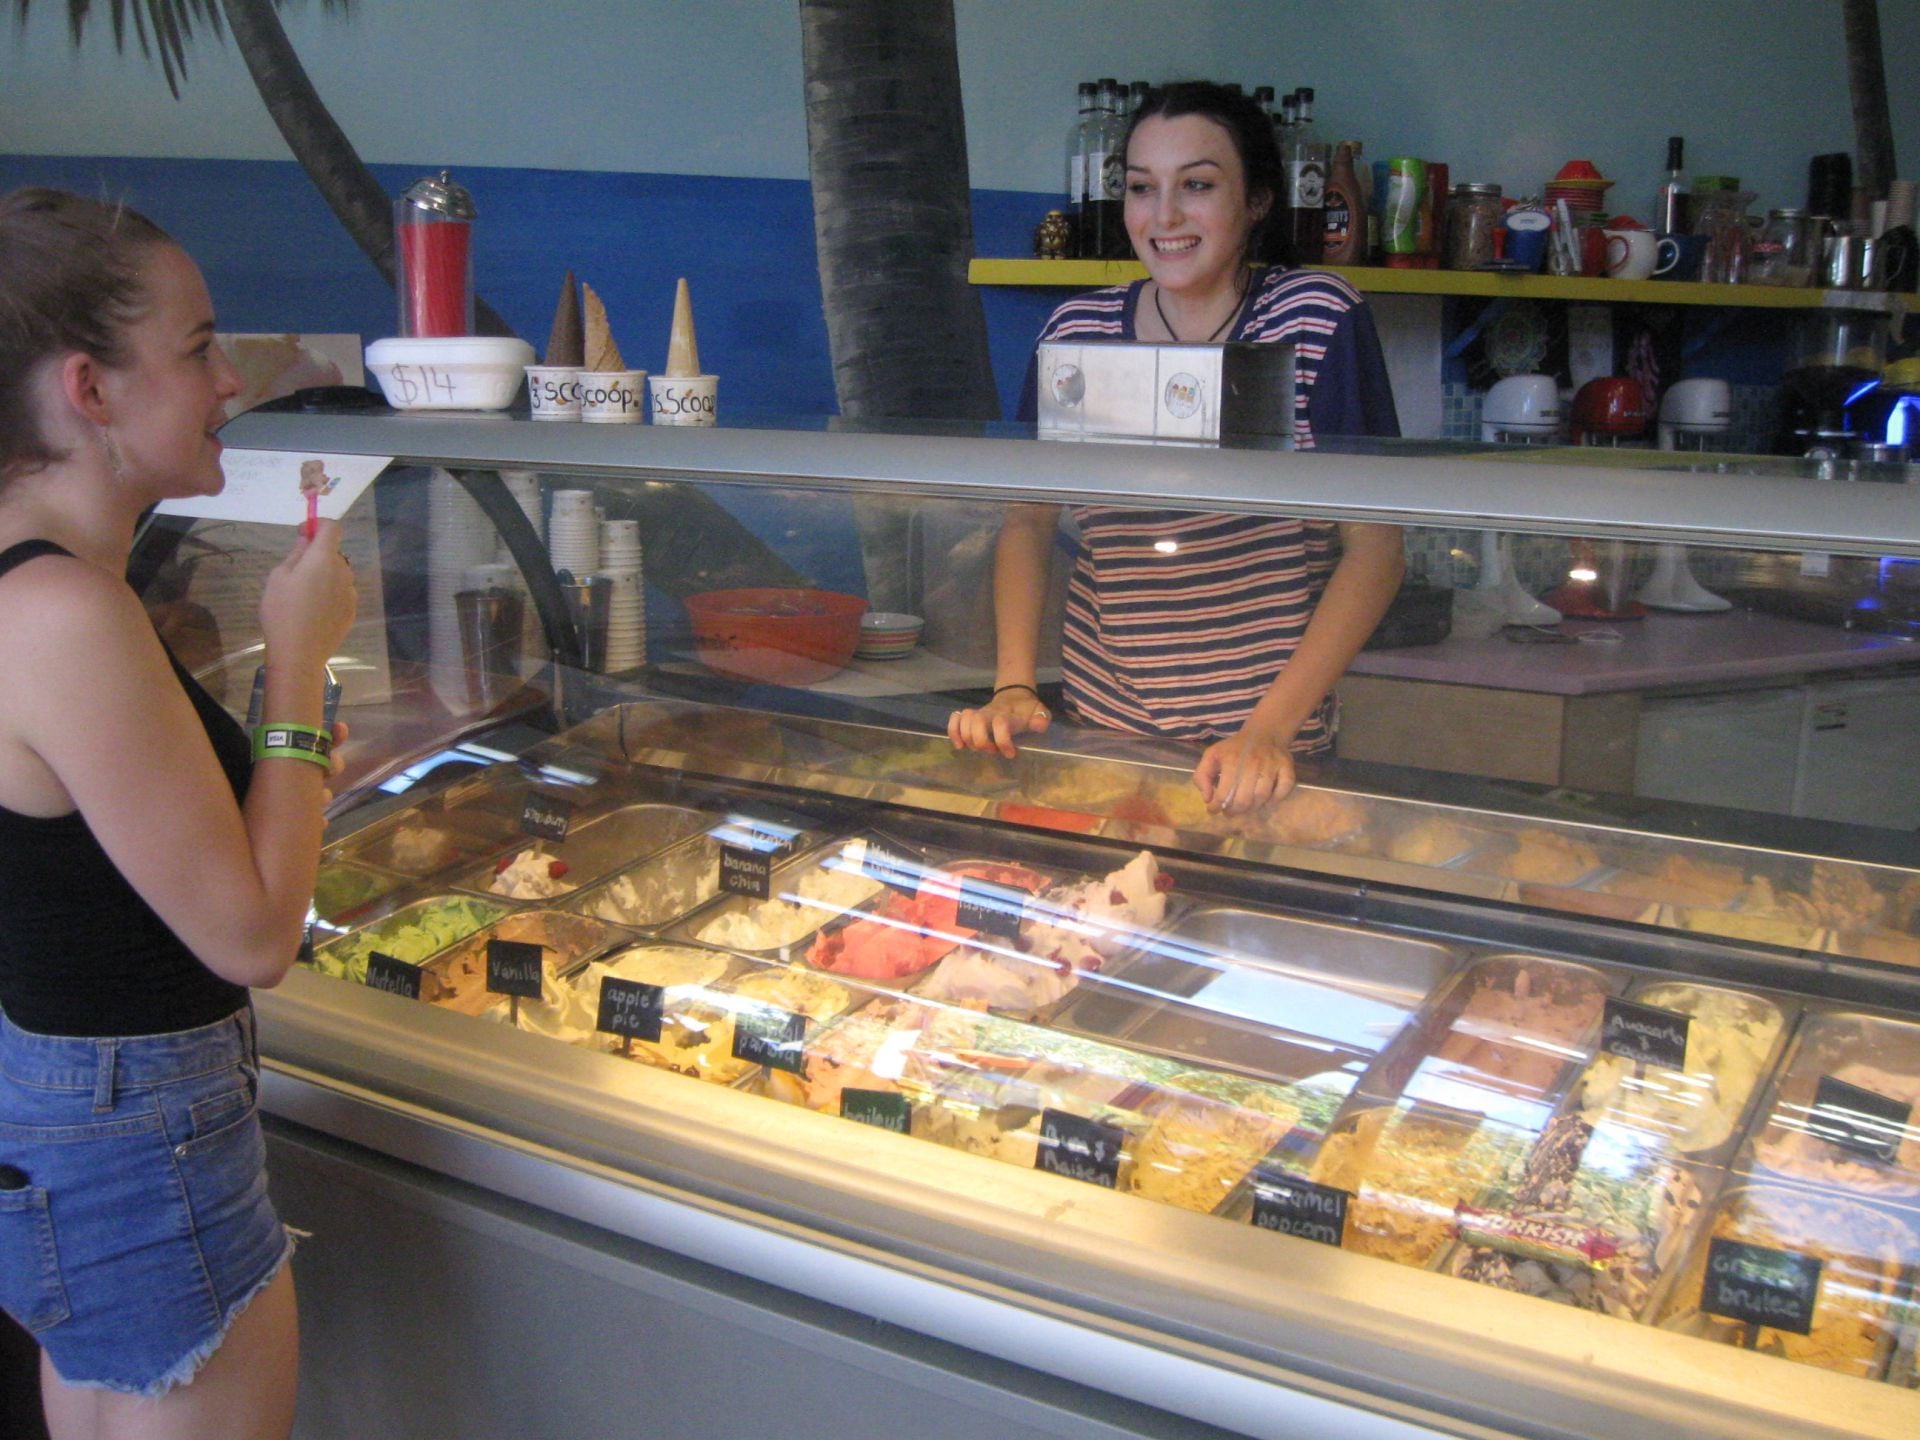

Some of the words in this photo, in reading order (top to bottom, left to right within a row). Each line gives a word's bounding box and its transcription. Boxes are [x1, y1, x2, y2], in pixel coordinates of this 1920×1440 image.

[390, 362, 457, 406] $14
[722, 852, 767, 877] banana
[367, 967, 413, 997] Nutella
[607, 987, 651, 1014] apple
[611, 1012, 641, 1030] pie
